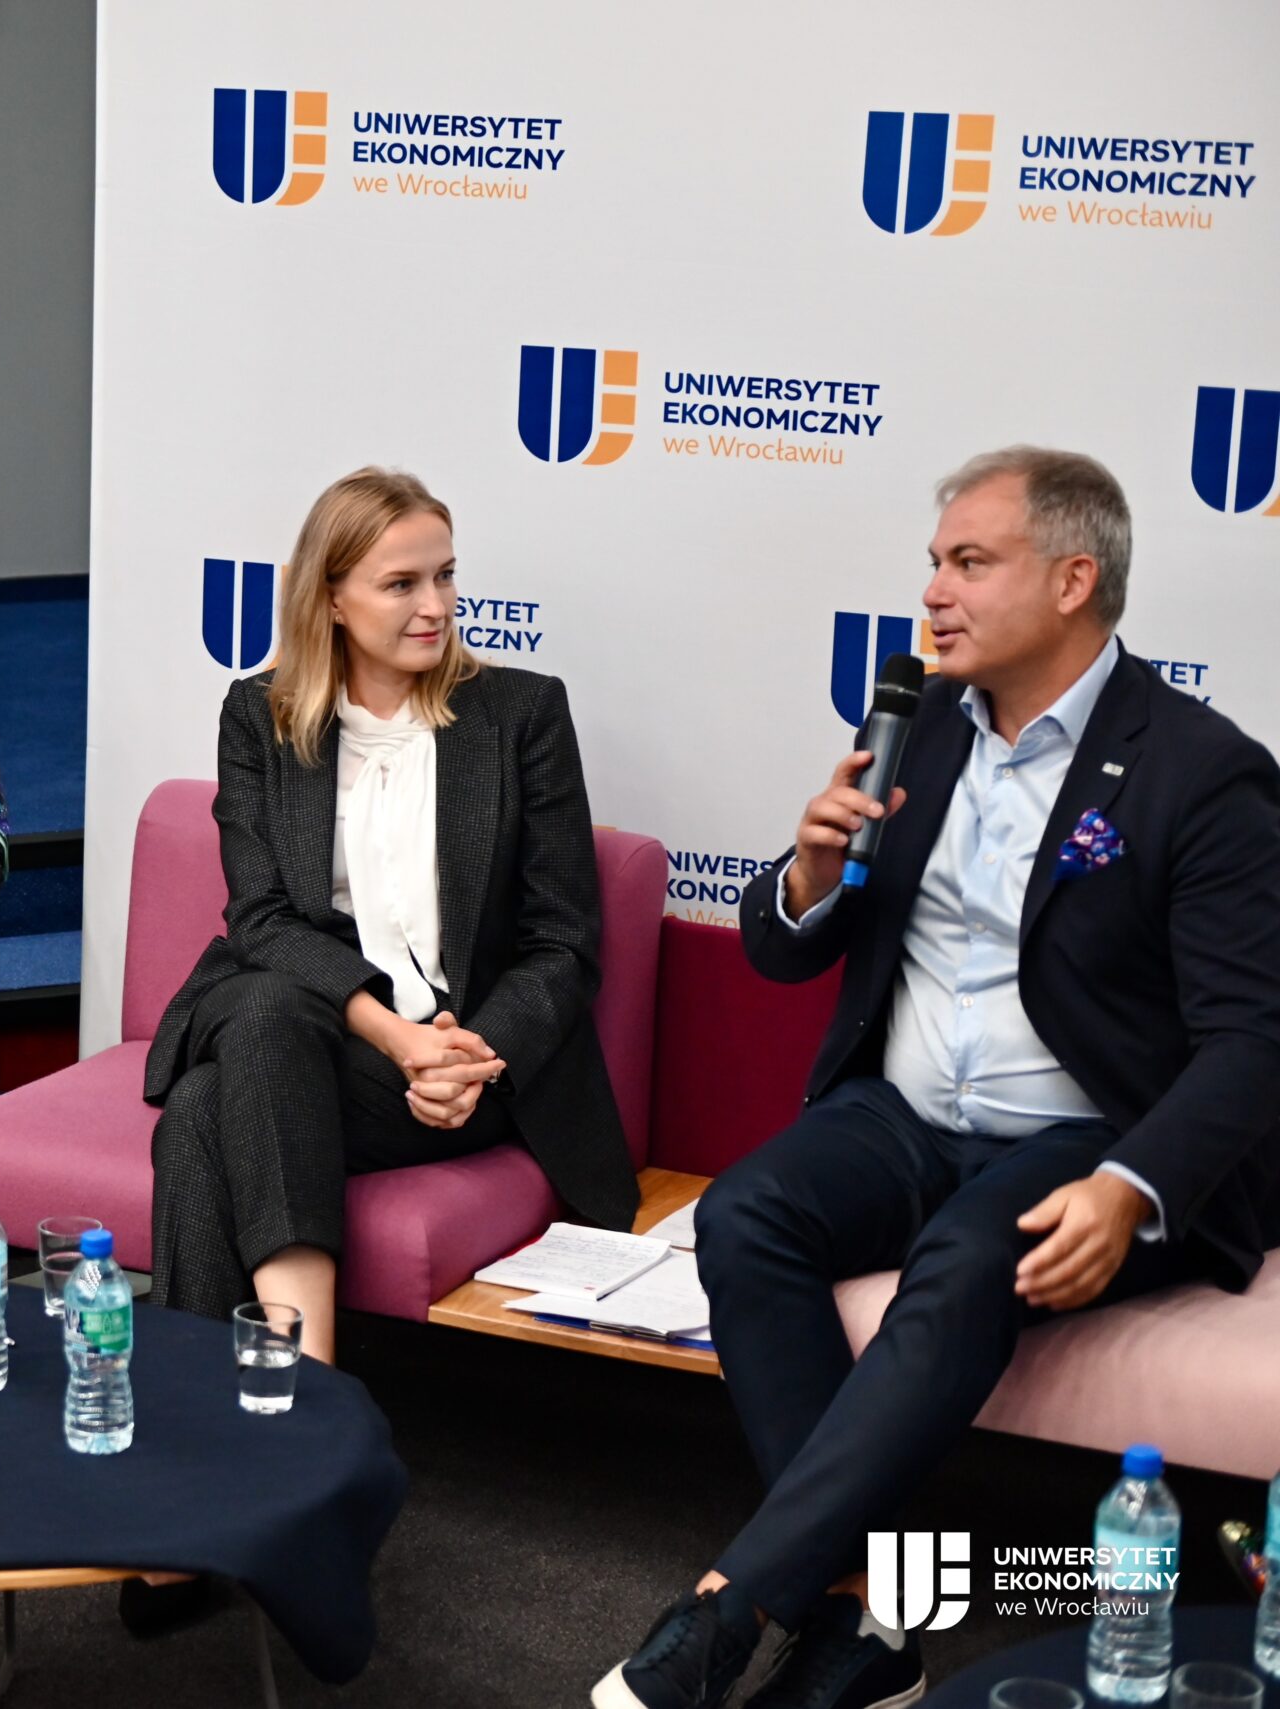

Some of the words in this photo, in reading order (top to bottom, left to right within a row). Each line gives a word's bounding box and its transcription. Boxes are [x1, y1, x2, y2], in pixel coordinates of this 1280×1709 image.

[353, 111, 563, 141] UNIWERSYTET
[353, 141, 565, 171] EKONOMICZNY
[1021, 135, 1255, 166] UNIWERSYTET
[353, 175, 389, 194] we
[396, 172, 528, 201] Wrocławiu
[1019, 166, 1256, 199] EKONOMICZNY
[1018, 203, 1058, 224] we
[1067, 200, 1213, 230] Wrocławiu
[664, 371, 881, 406] UNIWERSYTET
[663, 401, 883, 437] EKONOMICZNY
[662, 436, 700, 456] we
[708, 434, 844, 465] Wrocławiu
